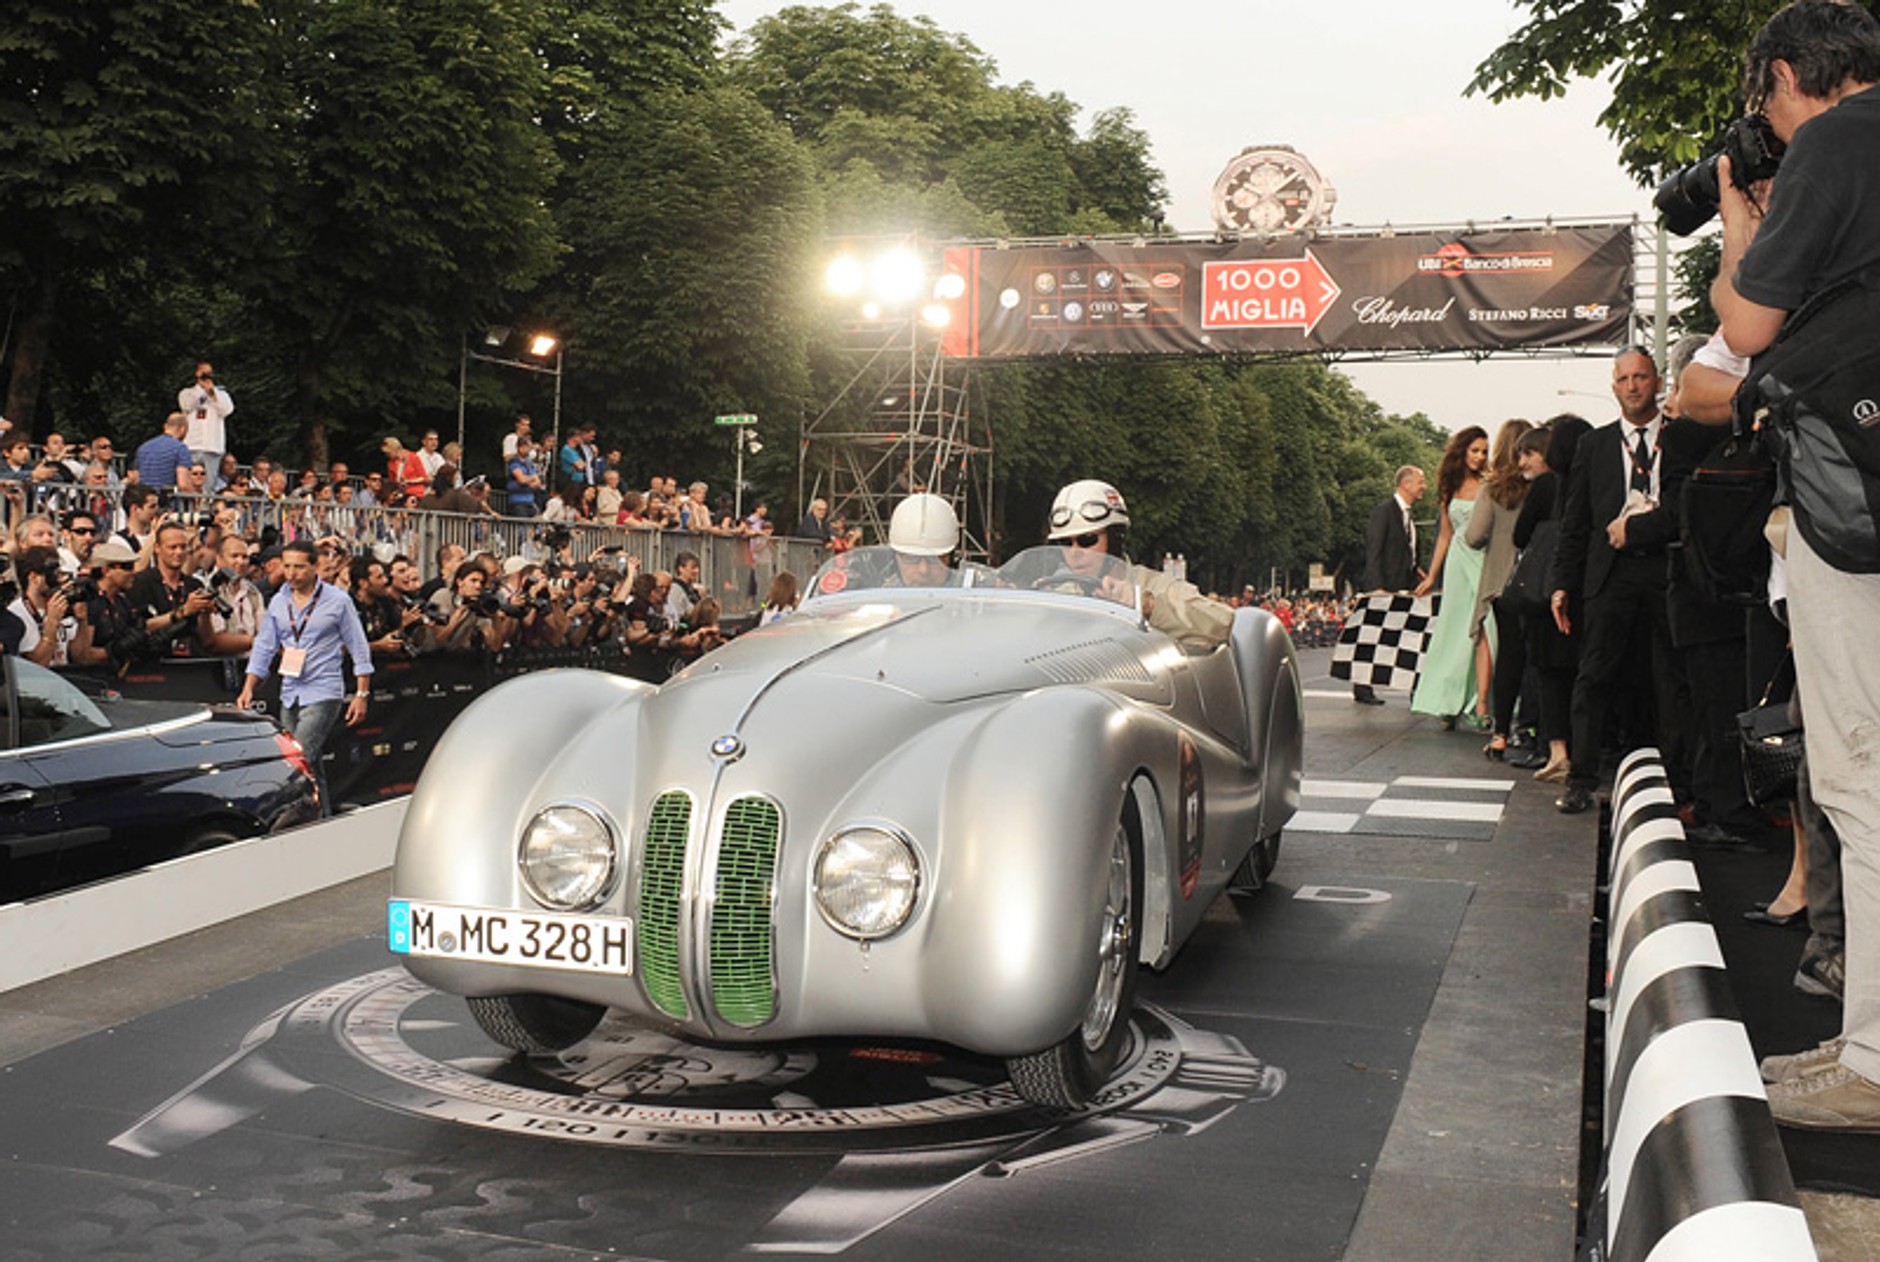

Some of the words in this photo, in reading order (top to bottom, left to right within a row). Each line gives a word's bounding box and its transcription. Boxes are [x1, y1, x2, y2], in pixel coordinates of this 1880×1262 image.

[1418, 258, 1441, 270] UBI
[1216, 267, 1300, 290] 1000
[1210, 298, 1306, 321] MIGLIA
[1351, 296, 1456, 329] Chopard
[1529, 306, 1567, 319] RICCI
[412, 909, 434, 948] M
[460, 914, 509, 955] MC
[524, 1118, 597, 1135] 120
